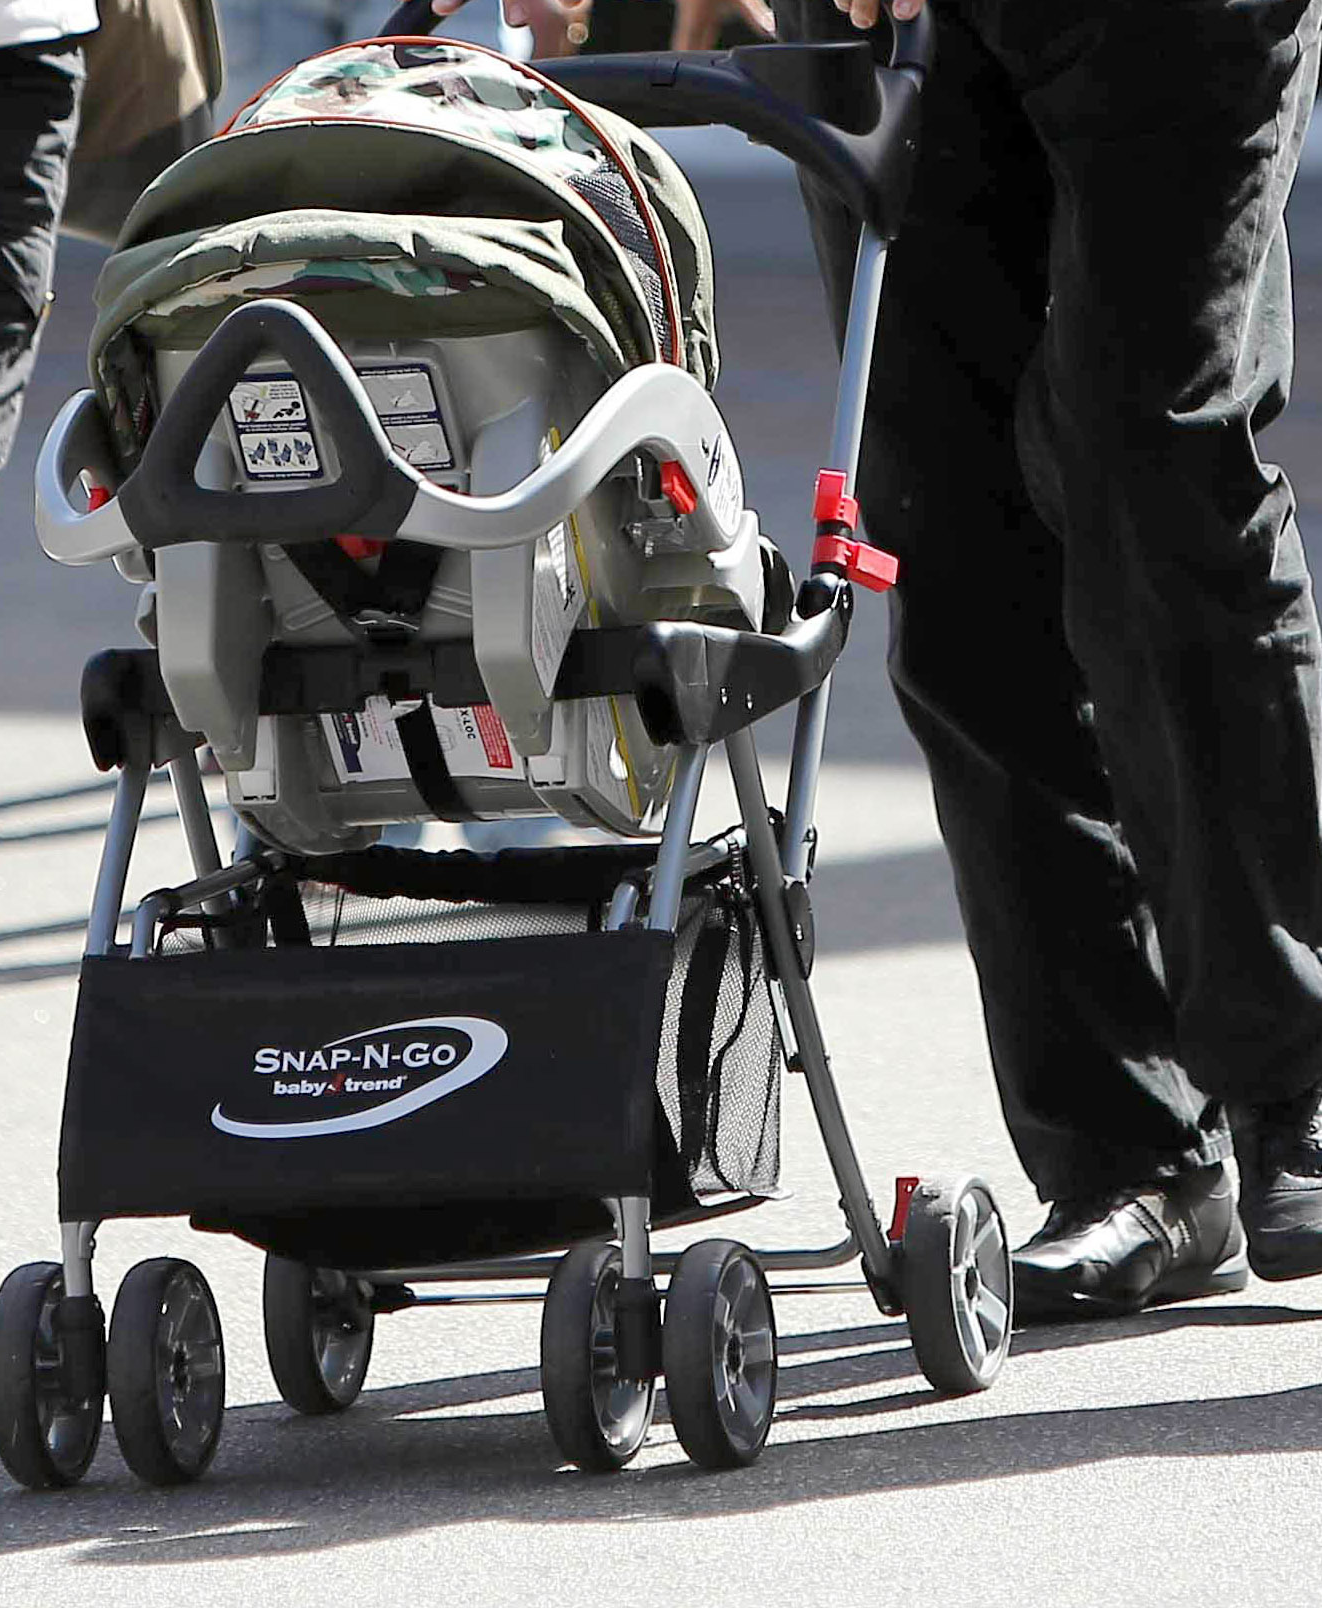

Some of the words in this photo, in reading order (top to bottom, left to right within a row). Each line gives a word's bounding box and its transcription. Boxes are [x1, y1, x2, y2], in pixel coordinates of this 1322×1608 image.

[253, 1042, 456, 1074] SNAP-N-GO
[273, 1079, 326, 1097] baby
[344, 1076, 403, 1092] trend
